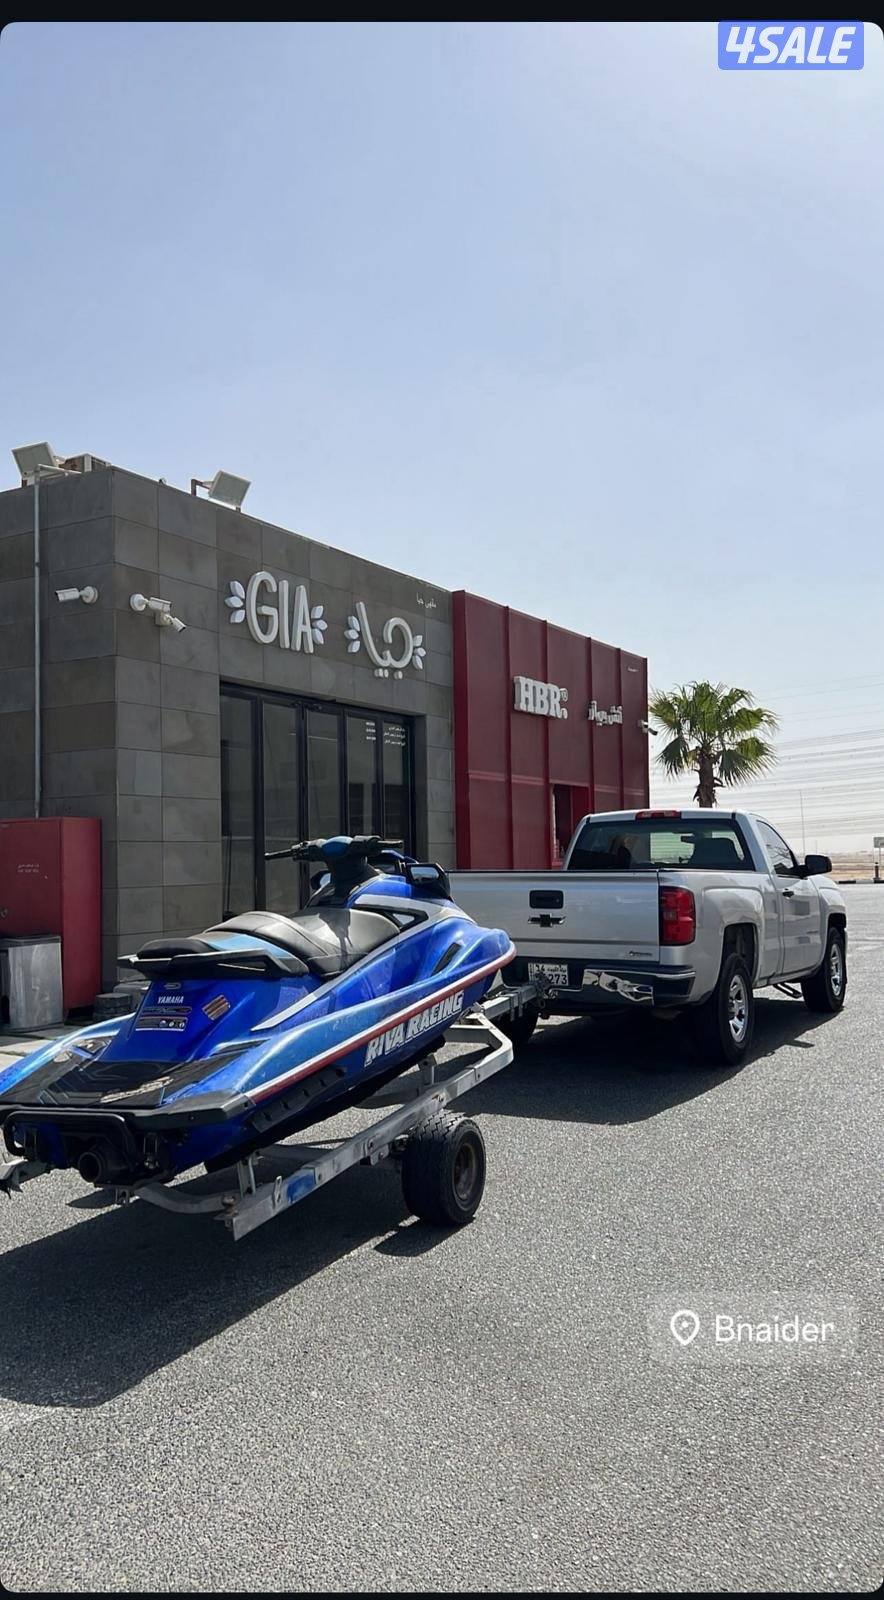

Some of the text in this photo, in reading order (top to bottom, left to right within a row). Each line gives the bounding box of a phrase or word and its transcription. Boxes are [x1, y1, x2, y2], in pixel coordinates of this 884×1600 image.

[246, 570, 314, 655] GIA
[356, 601, 414, 680] جيا
[157, 995, 185, 1005] YAMAHA
[541, 973, 568, 985] 273
[364, 989, 465, 1068] RIVA RACING
